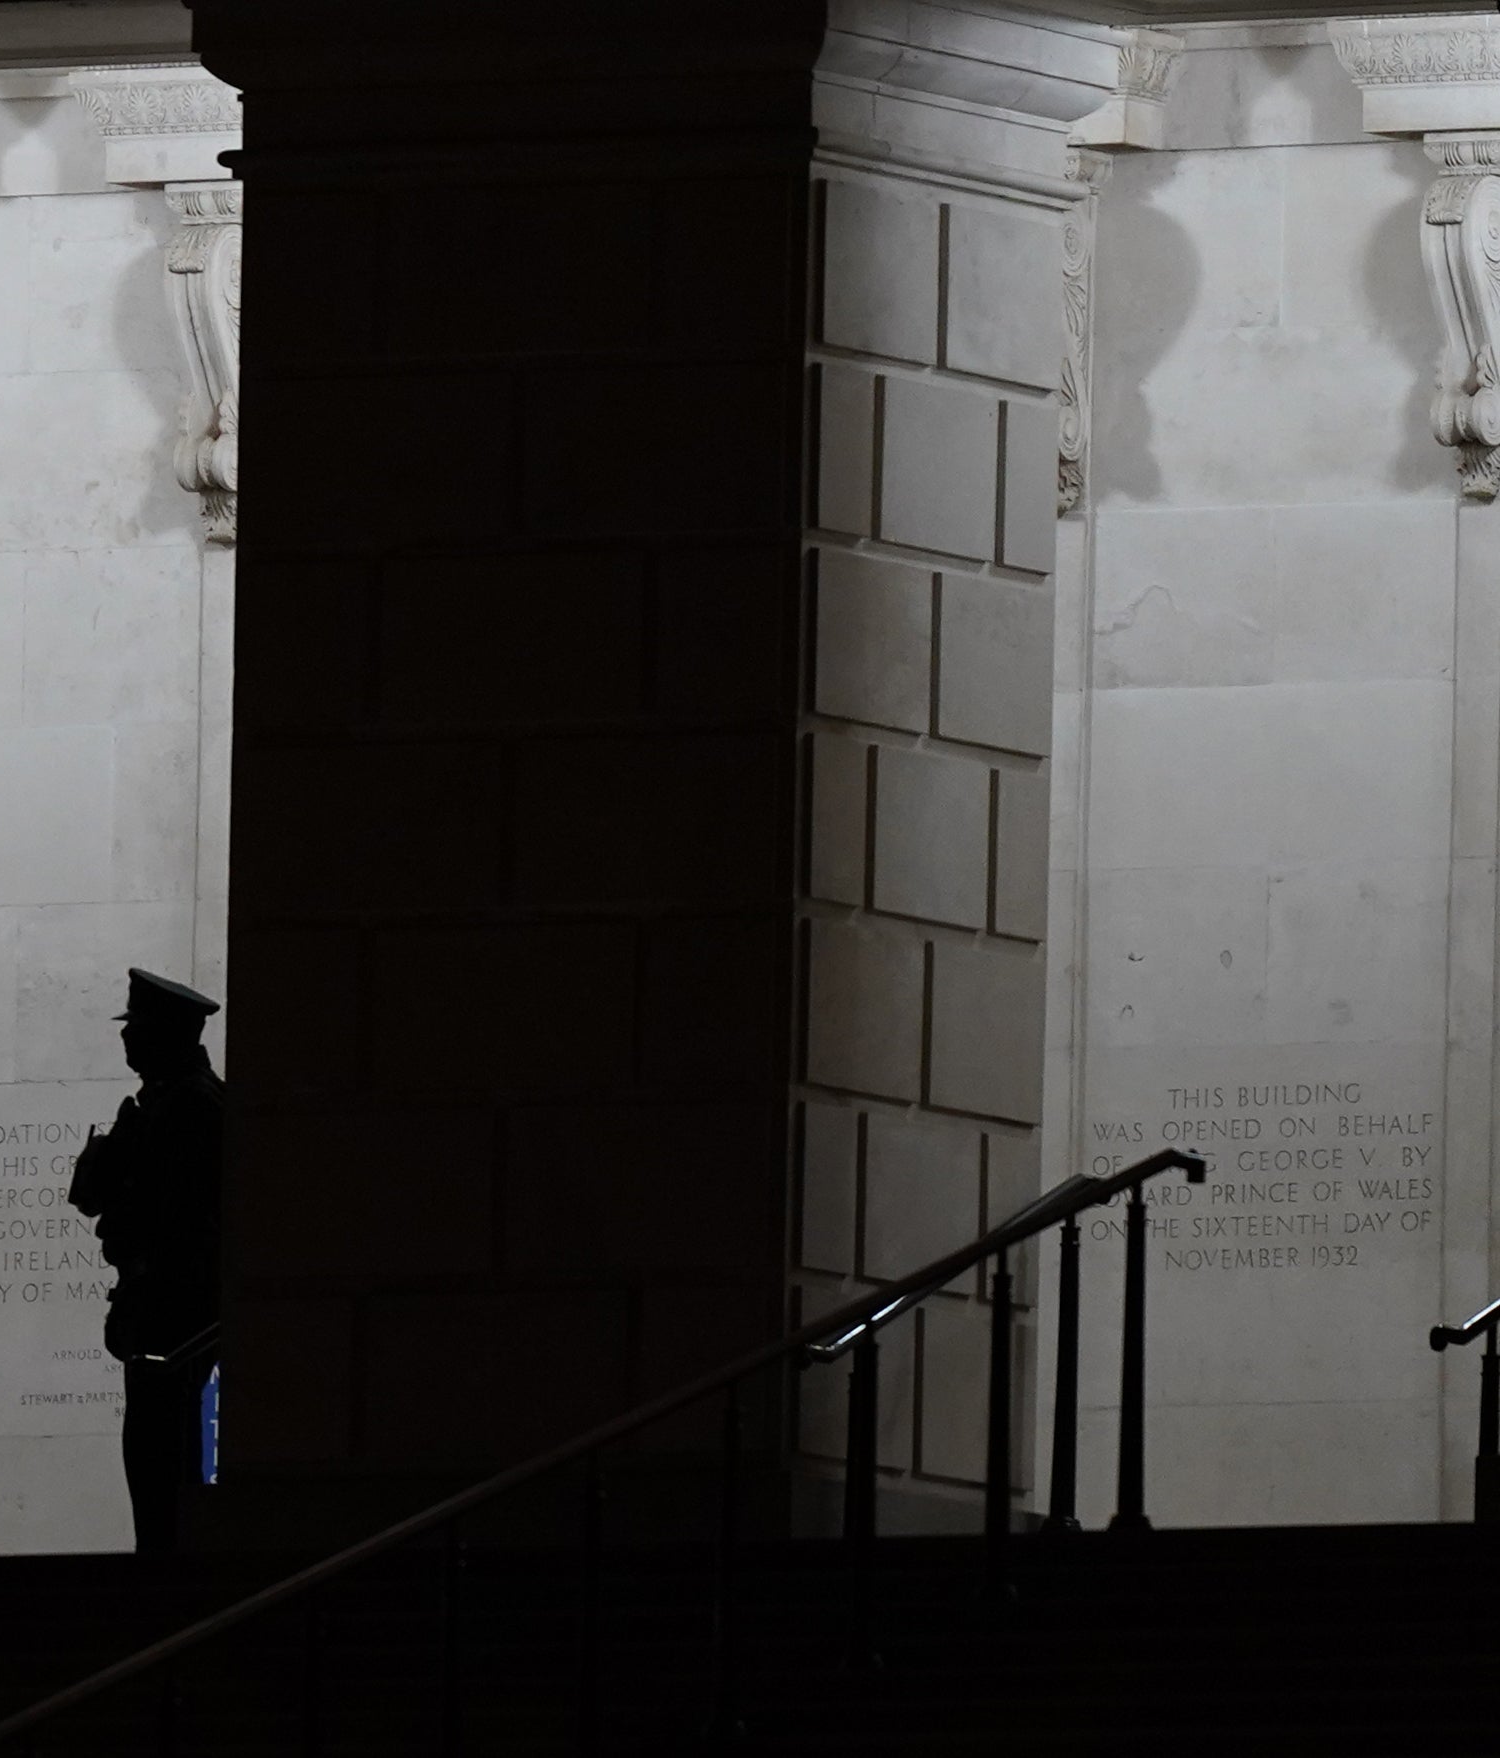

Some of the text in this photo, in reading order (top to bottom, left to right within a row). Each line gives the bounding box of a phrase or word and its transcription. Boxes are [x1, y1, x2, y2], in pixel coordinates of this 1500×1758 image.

[1167, 1082, 1362, 1110] THIS BUILDING
[1093, 1113, 1433, 1143] WAS OPENED ON BEHALF
[3, 1156, 40, 1177] HIS
[1092, 1155, 1124, 1176] OF
[1237, 1148, 1344, 1172] GEORGE
[1402, 1146, 1432, 1168] BY
[1211, 1182, 1299, 1205] PRINCE
[1313, 1181, 1344, 1202] OF
[1357, 1178, 1433, 1201] WALES
[1090, 1218, 1127, 1241] ON
[1192, 1213, 1328, 1240] SIXTEENTH
[1344, 1211, 1391, 1234] DAY
[1400, 1210, 1432, 1232] OF
[1164, 1245, 1358, 1272] NOVEMBER 1932
[22, 1282, 53, 1304] OF
[65, 1280, 113, 1301] MAY
[52, 1349, 102, 1361] ARNOLD
